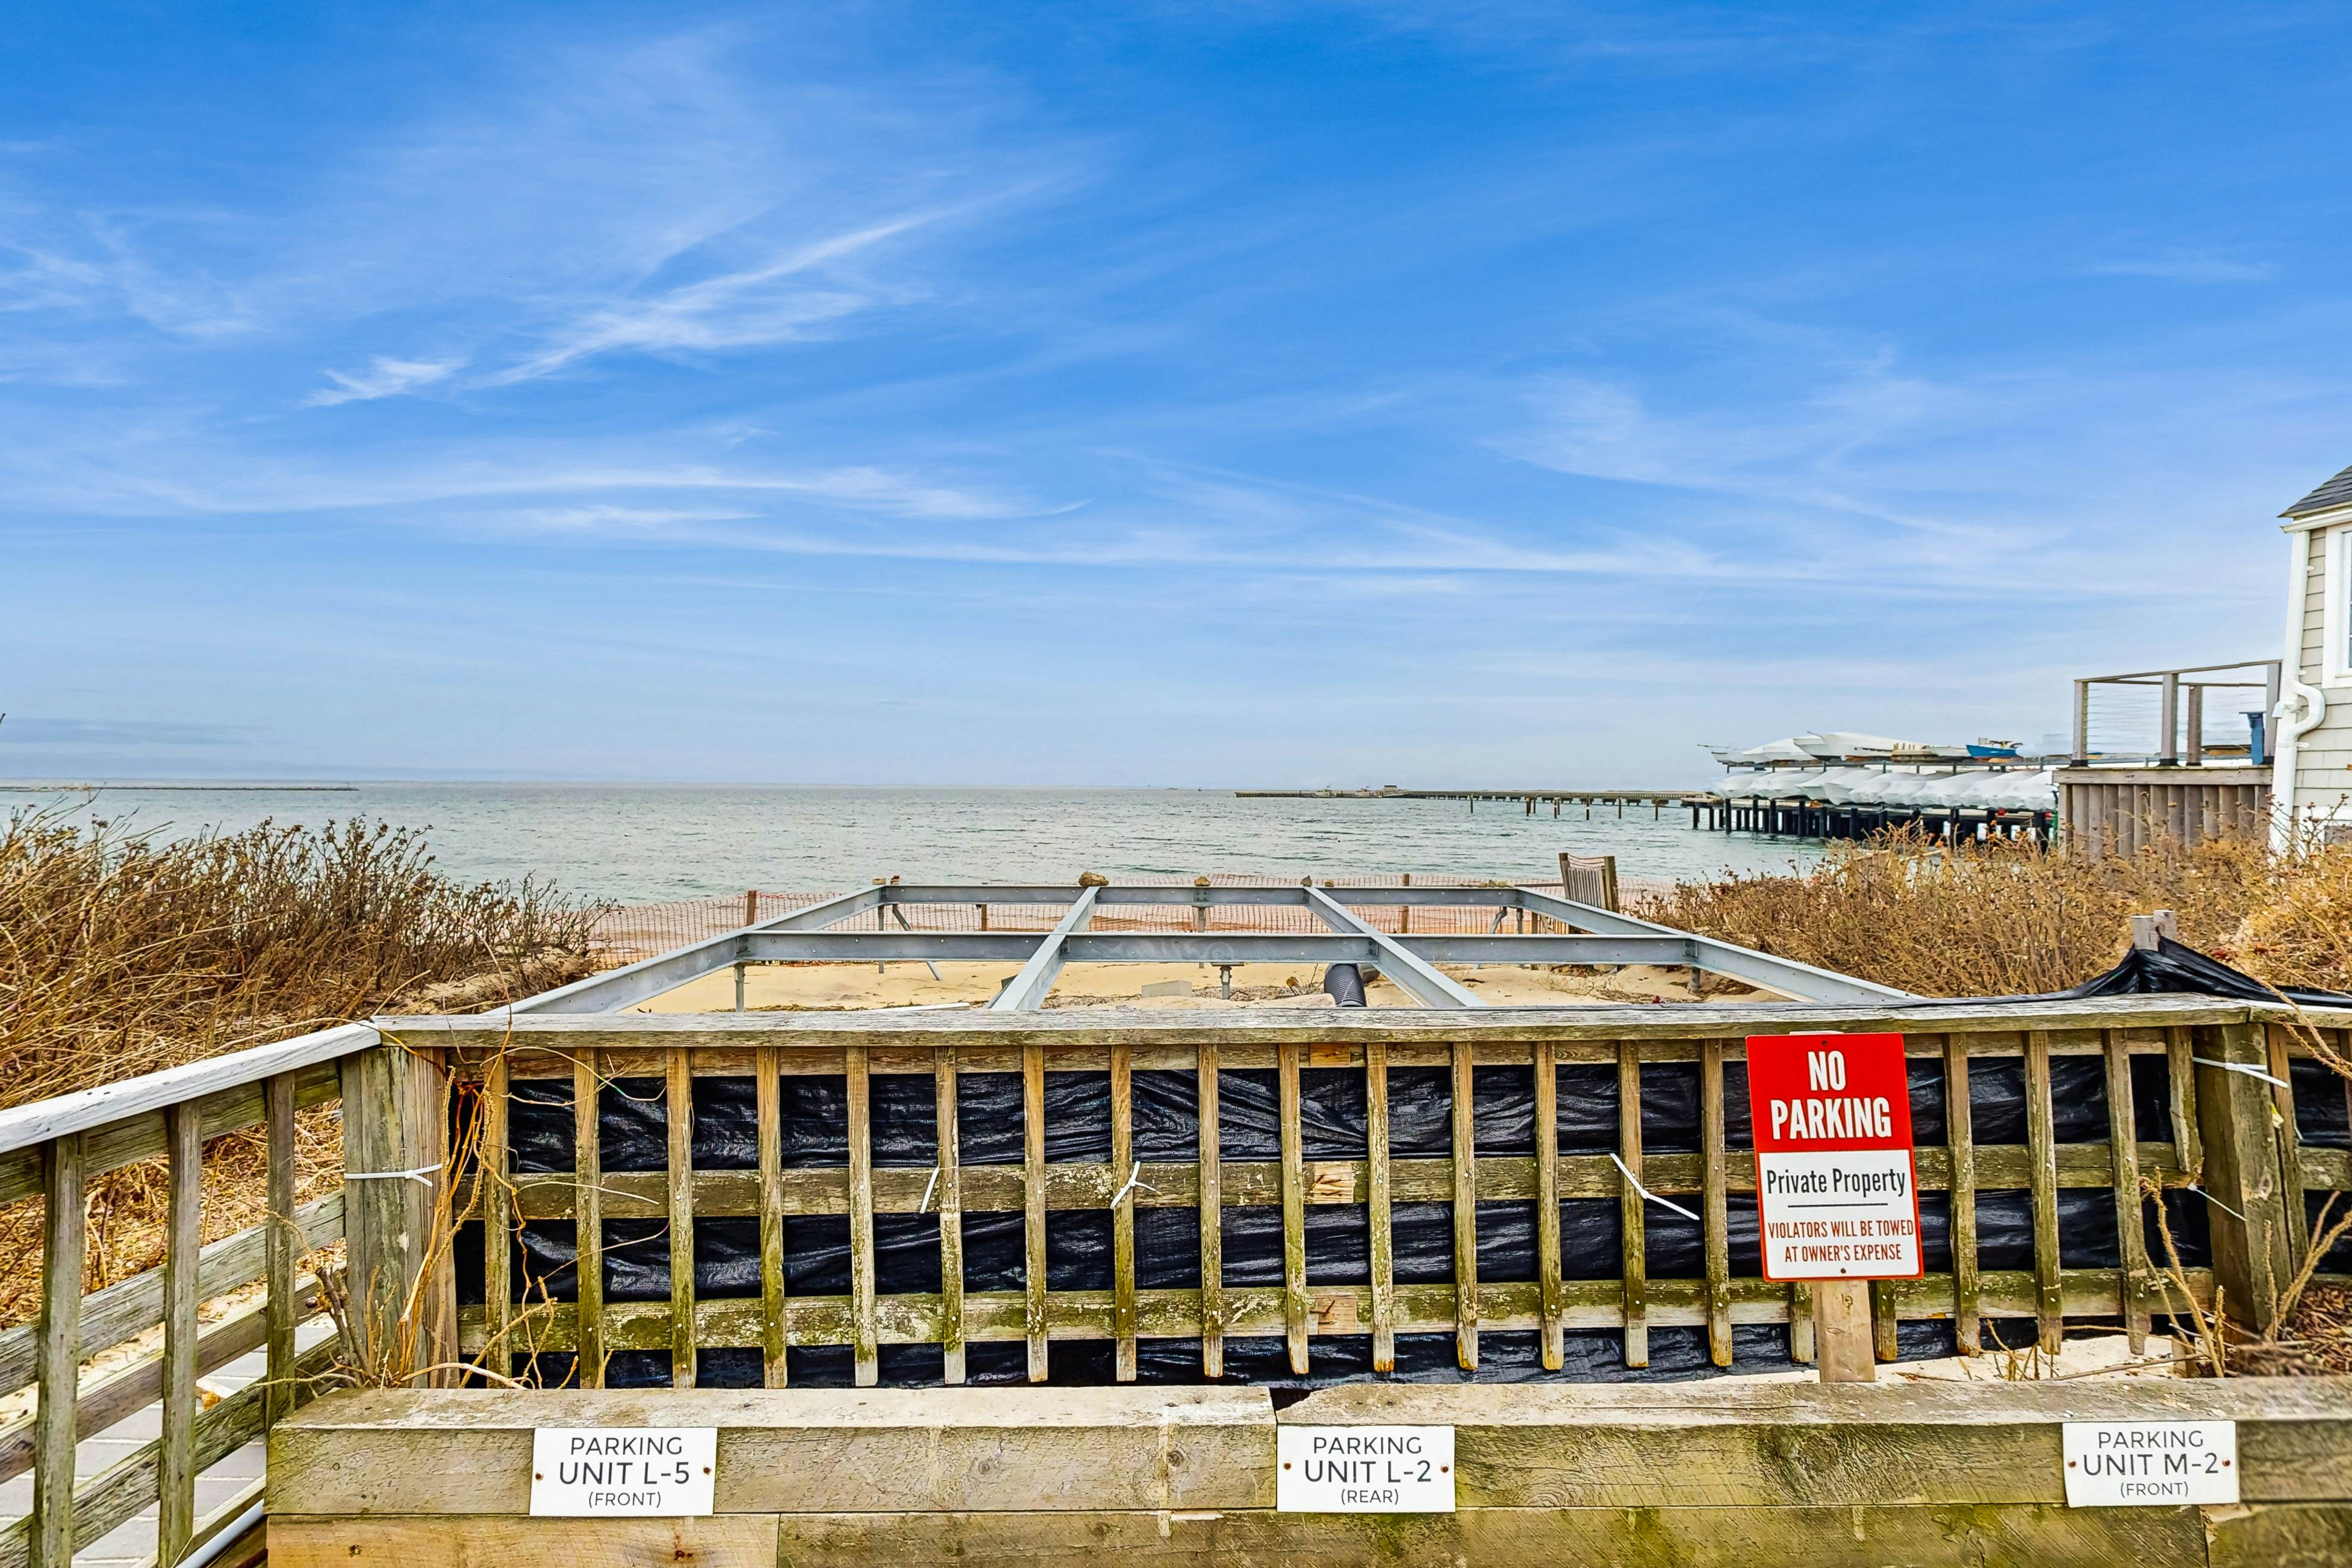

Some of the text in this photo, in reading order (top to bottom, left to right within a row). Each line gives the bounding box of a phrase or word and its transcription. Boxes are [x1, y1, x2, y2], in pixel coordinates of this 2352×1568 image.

[1807, 1050, 1846, 1092] NO
[1770, 1097, 1892, 1140] PARKING
[1766, 1168, 1905, 1197] Private Property
[1768, 1219, 1914, 1239] VIOLATORS WILL BE TOWED
[1784, 1243, 1902, 1262] AT OWNER'S EXPENSE
[571, 1437, 682, 1455] PARKING
[1313, 1437, 1422, 1454] PARKING
[2098, 1430, 2203, 1448] PARKING
[559, 1461, 689, 1485] UNIT L-5
[1304, 1460, 1431, 1483] UNIT L-2
[2083, 1452, 2219, 1476] UNIT M-2
[1341, 1489, 1399, 1505] (REAR)
[2120, 1481, 2188, 1498] (FRONT)
[588, 1492, 661, 1508] (FRONT)
